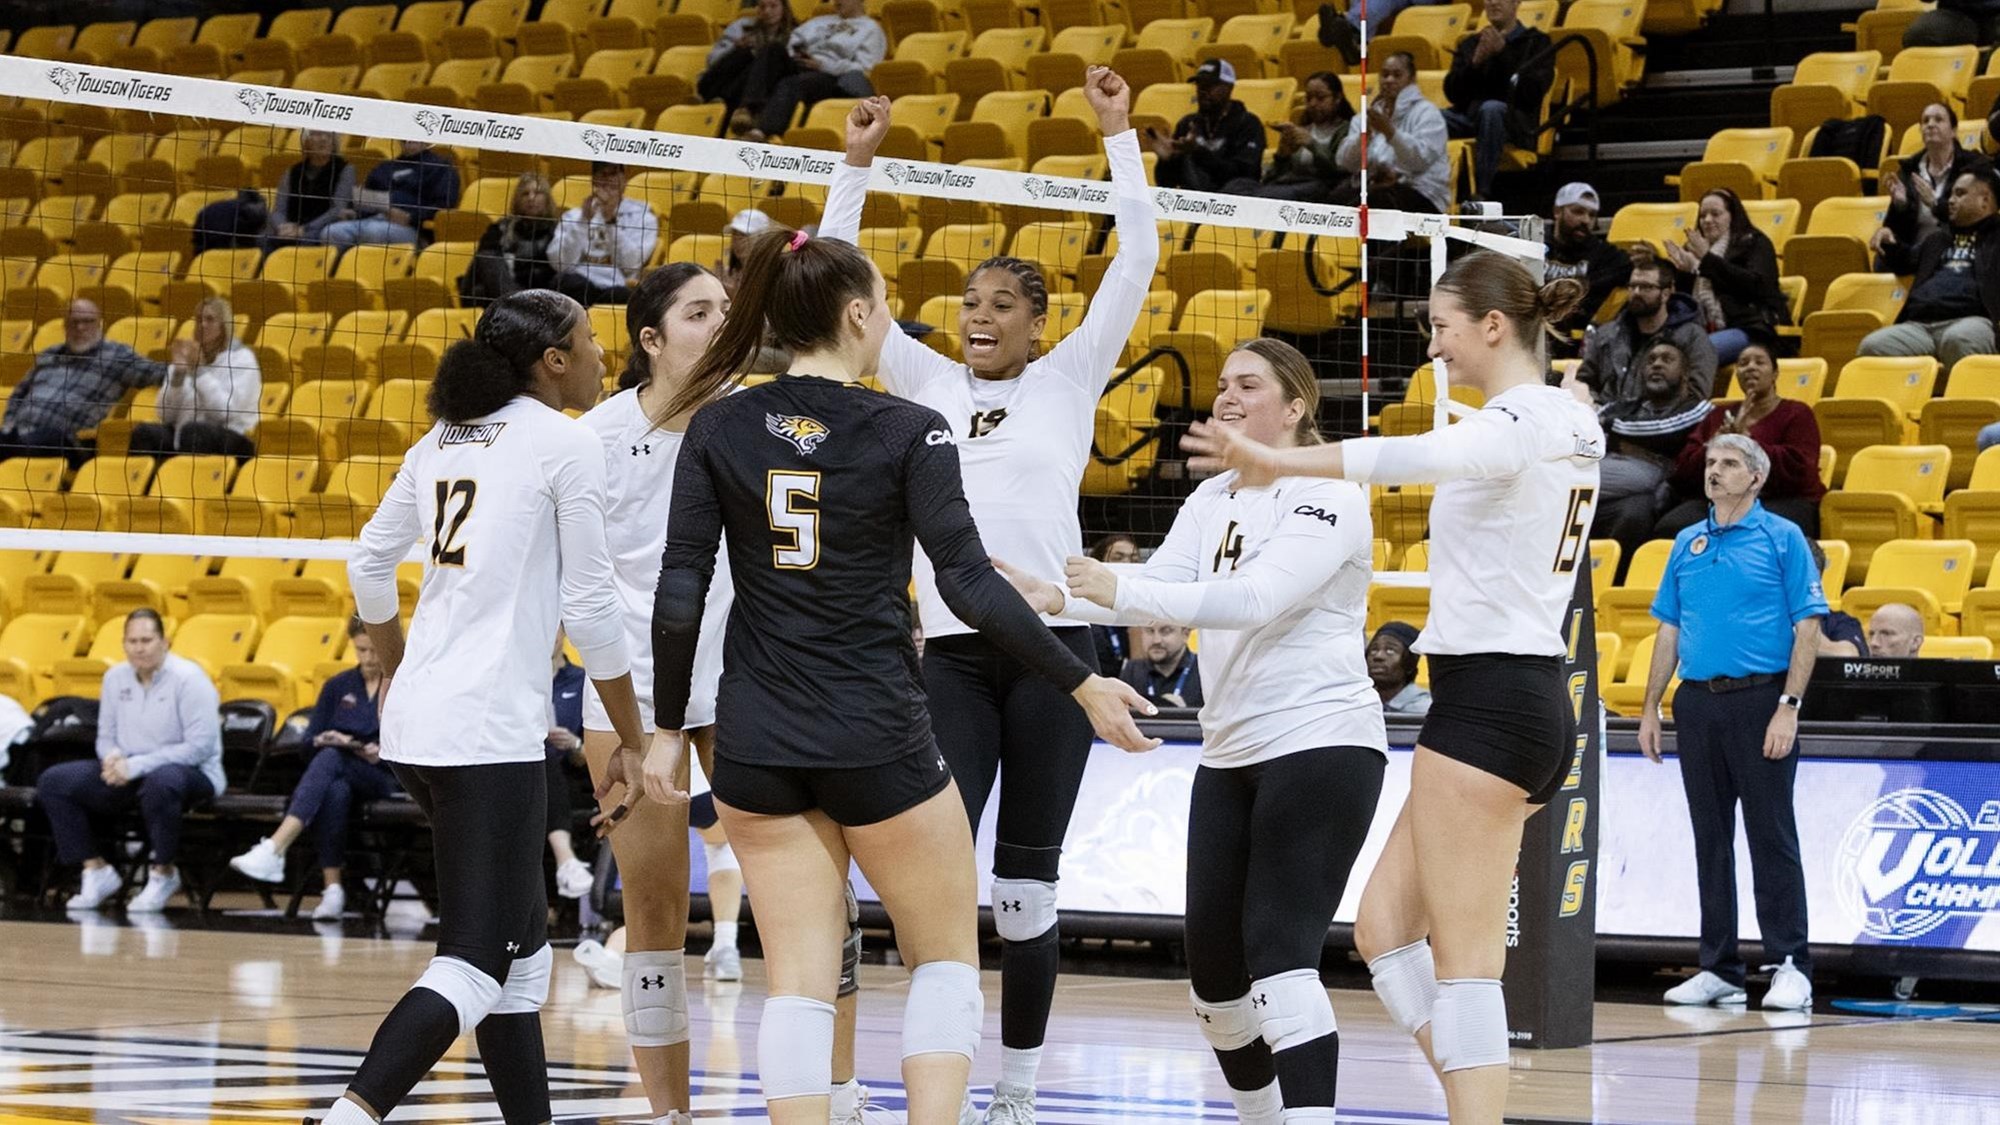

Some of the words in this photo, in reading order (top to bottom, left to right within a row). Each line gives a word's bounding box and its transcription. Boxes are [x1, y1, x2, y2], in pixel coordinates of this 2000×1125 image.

[438, 422, 508, 450] TOWSON
[925, 429, 956, 446] CA
[432, 478, 477, 568] 12
[766, 469, 821, 571] 5
[1213, 520, 1245, 573] 14
[1294, 505, 1337, 527] CAA
[1552, 486, 1596, 576] 15
[1557, 608, 1588, 918] IGERS
